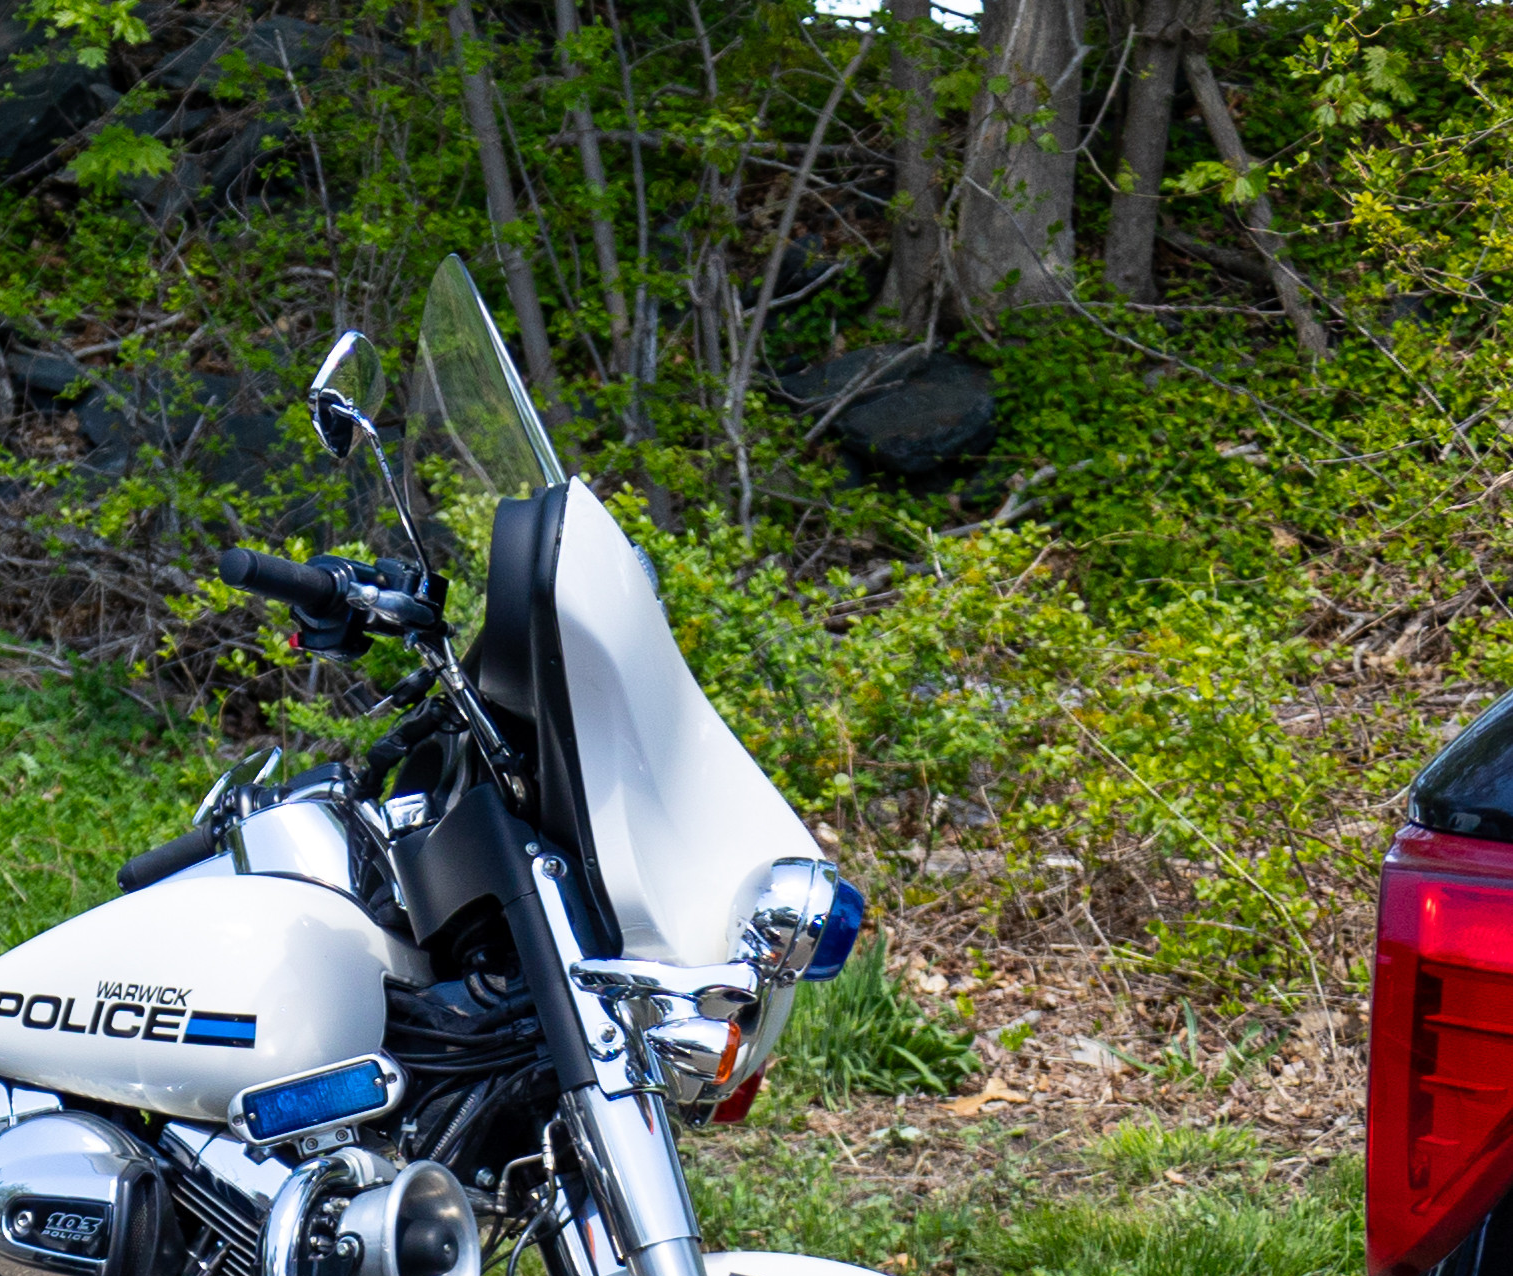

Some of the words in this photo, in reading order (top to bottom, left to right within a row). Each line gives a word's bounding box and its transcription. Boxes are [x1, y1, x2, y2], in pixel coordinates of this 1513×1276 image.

[96, 980, 193, 1007] WARWICK
[45, 1212, 103, 1234] 103
[41, 1229, 91, 1242] POLICE
